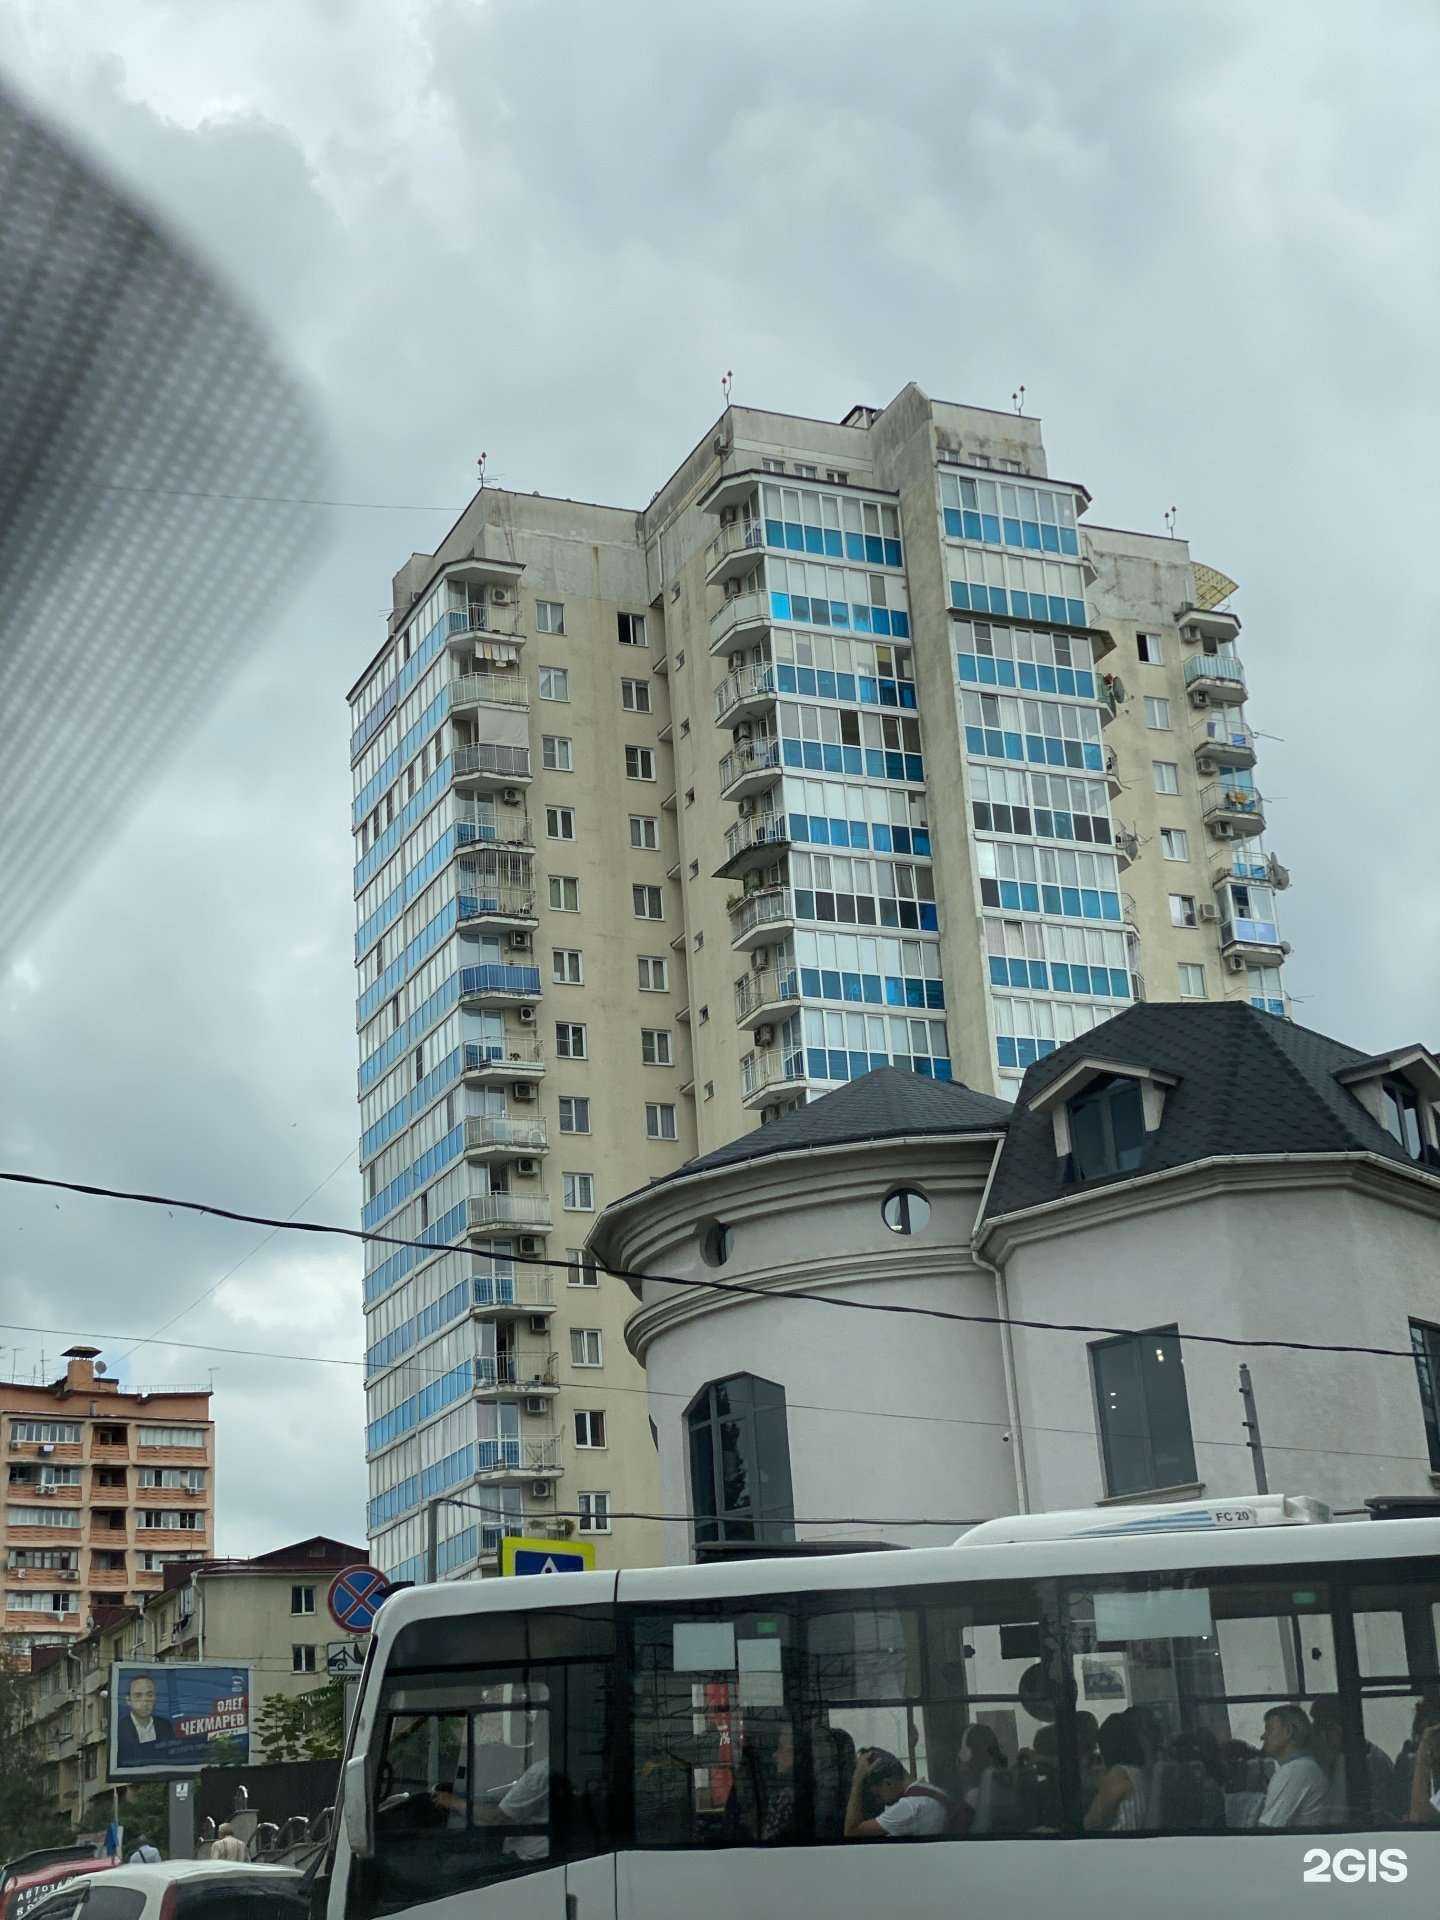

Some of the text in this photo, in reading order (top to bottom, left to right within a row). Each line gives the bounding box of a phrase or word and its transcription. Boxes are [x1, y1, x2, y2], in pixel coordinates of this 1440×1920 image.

[1215, 1511, 1250, 1522] FC 20
[217, 1697, 244, 1713] ОЛЕГ
[181, 1713, 245, 1736] ЧЕКМАРЕВ
